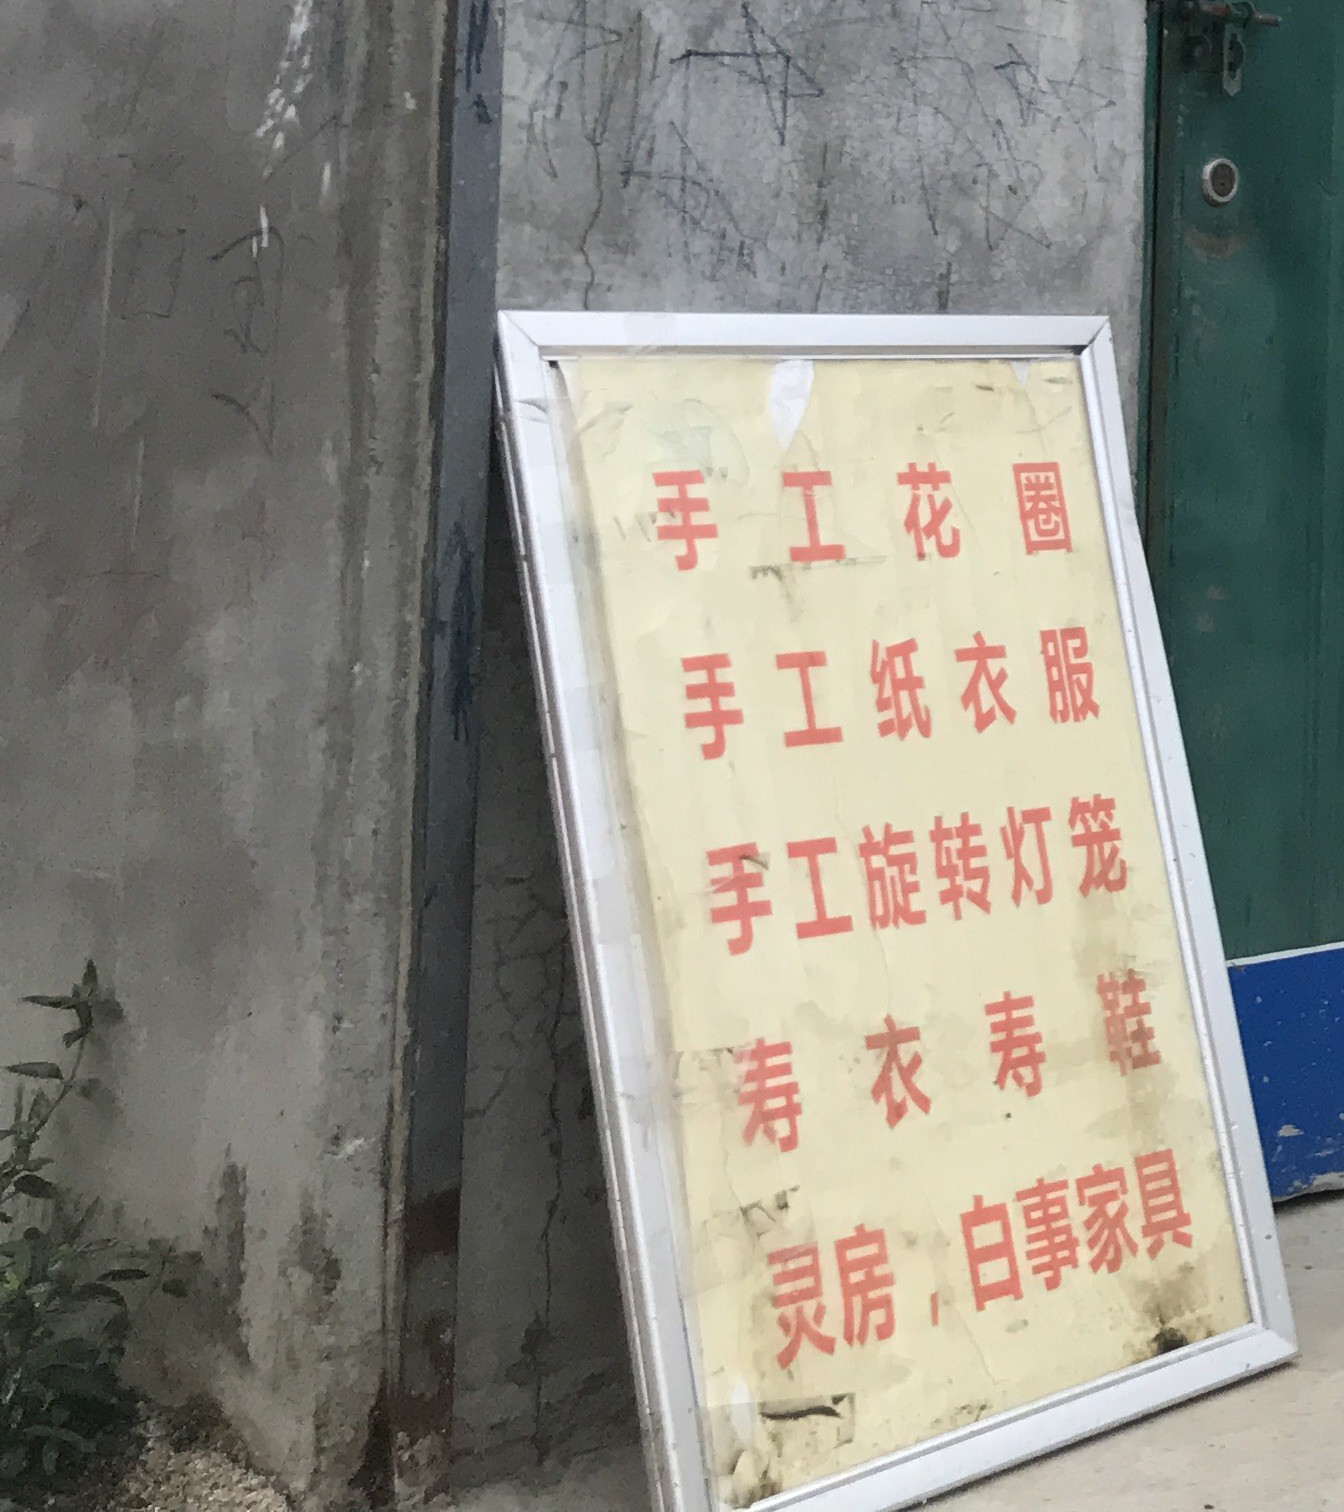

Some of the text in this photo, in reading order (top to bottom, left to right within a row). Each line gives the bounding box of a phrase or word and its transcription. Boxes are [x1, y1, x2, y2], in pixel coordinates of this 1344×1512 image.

[654, 462, 1072, 571] 手工花圈
[682, 626, 1100, 760] 手工纸衣服
[706, 794, 1127, 956] 手工旋转灯笼
[736, 968, 1162, 1153] 寿衣寿鞋
